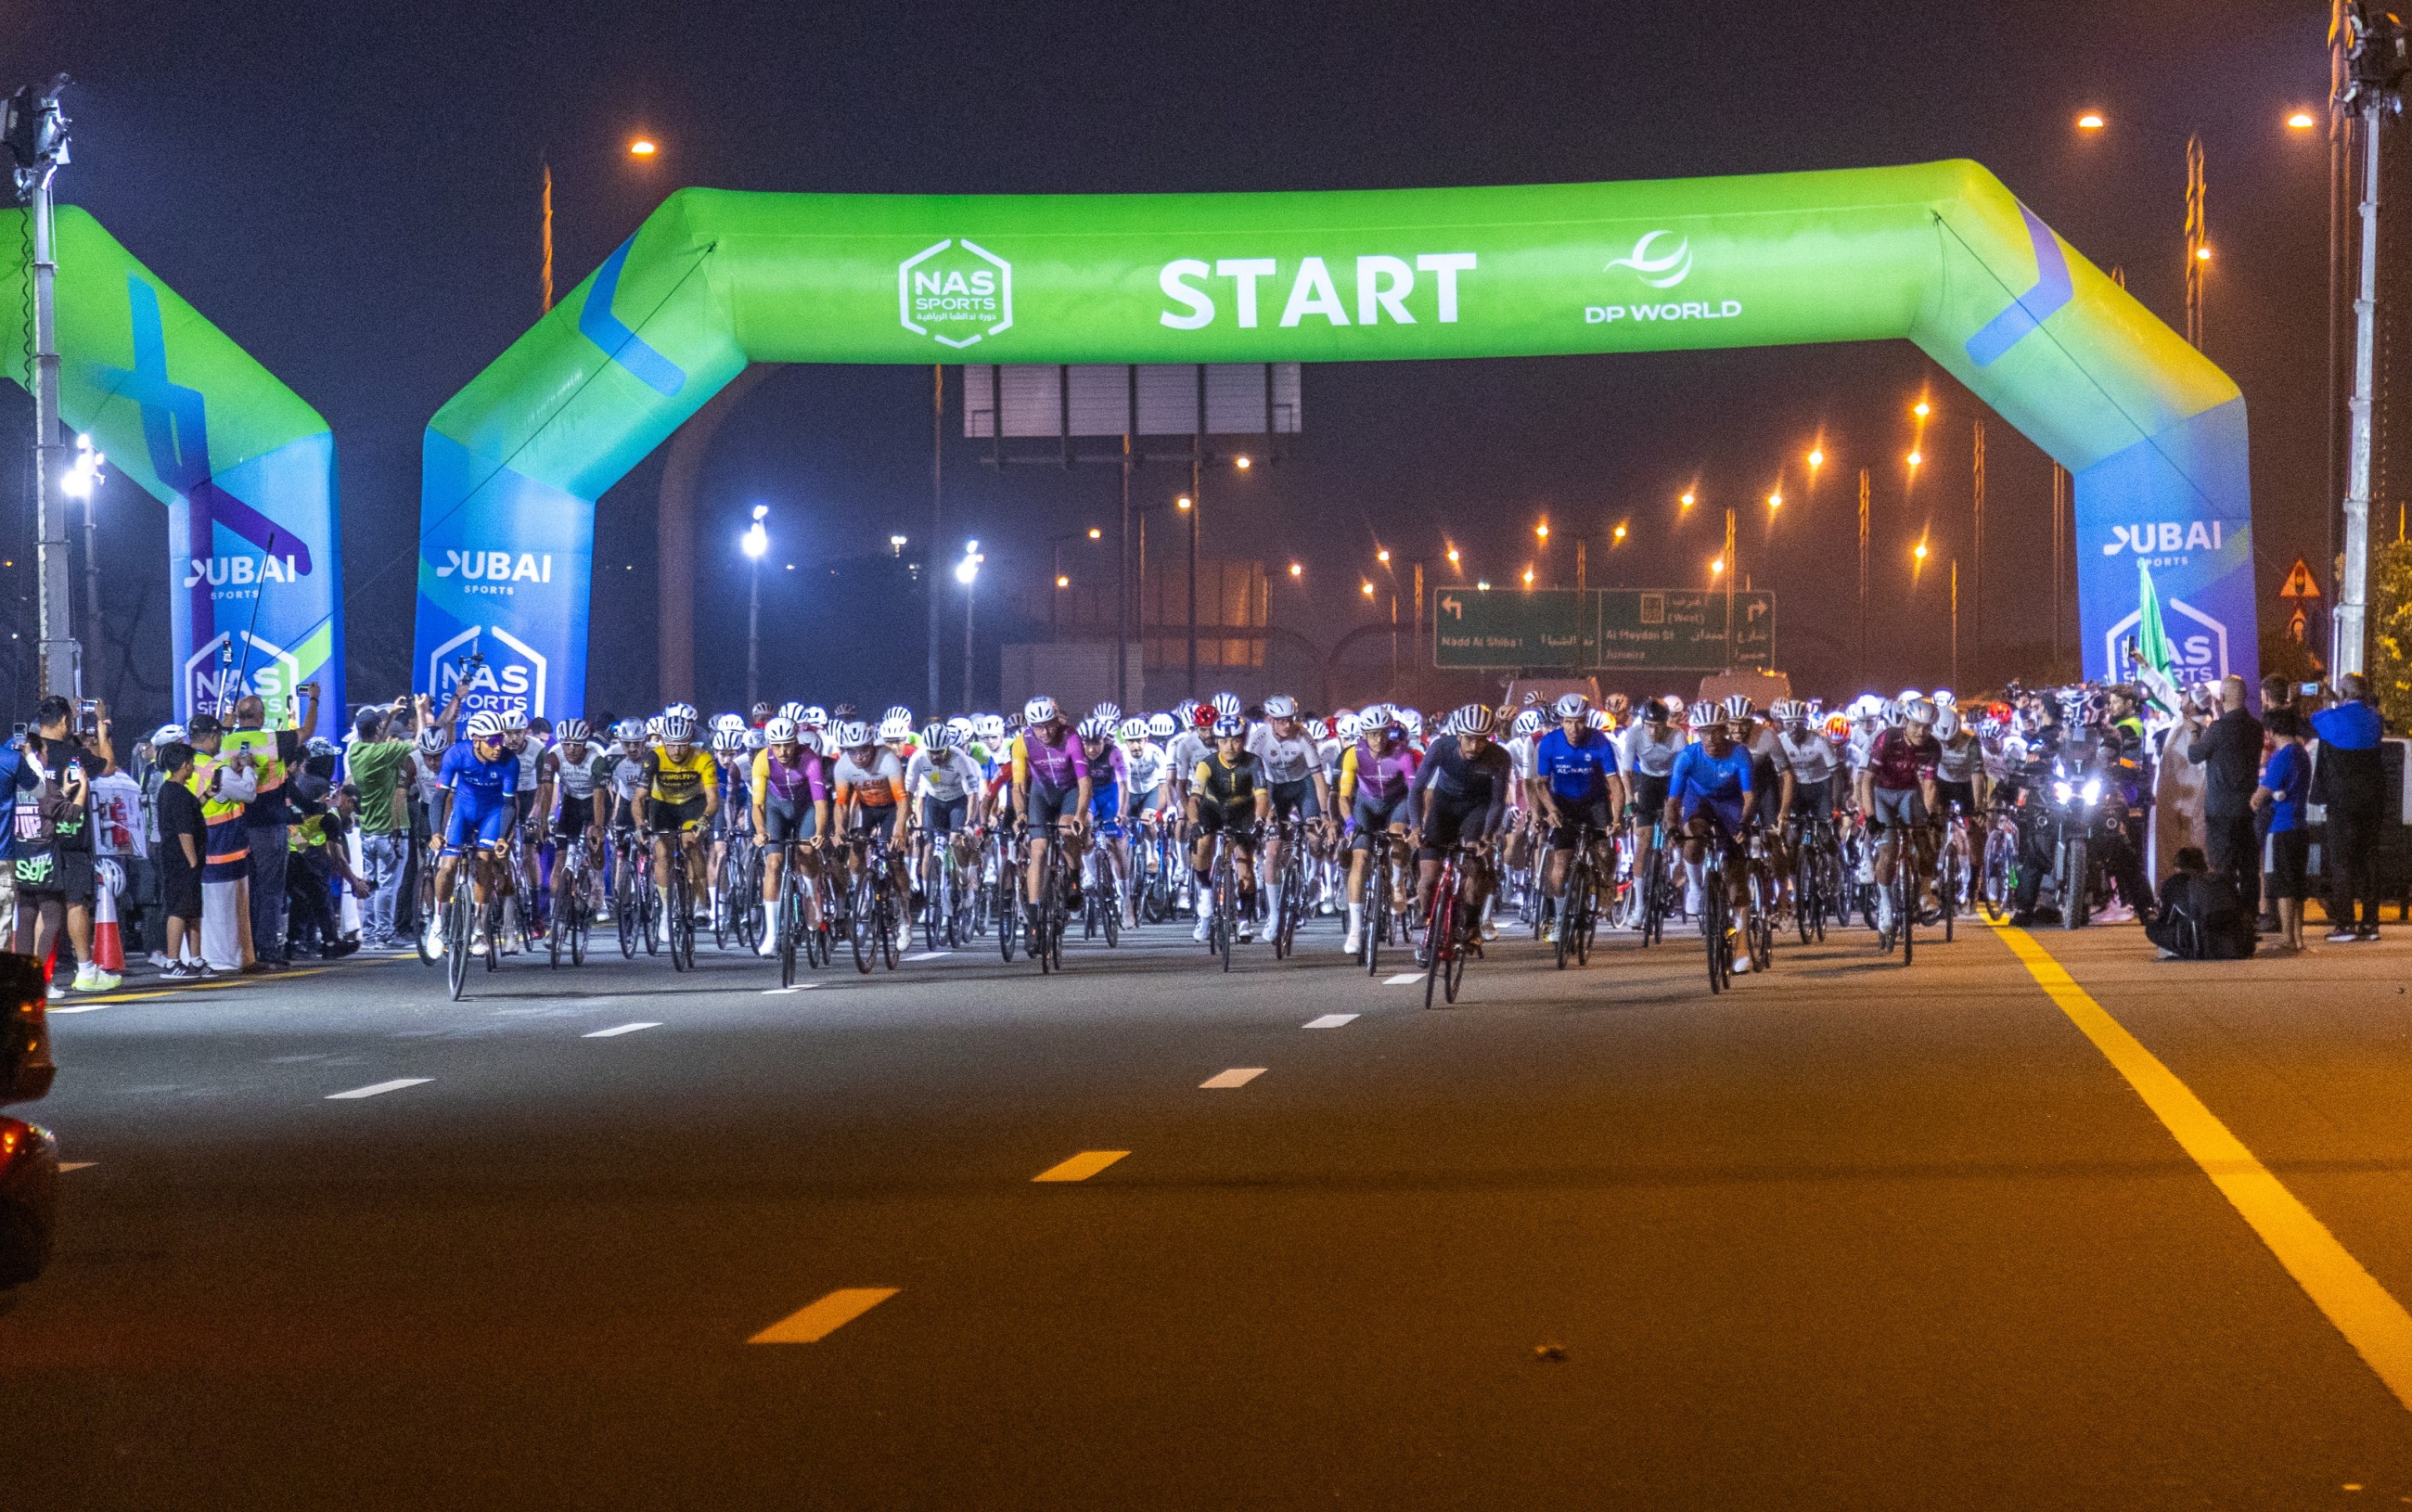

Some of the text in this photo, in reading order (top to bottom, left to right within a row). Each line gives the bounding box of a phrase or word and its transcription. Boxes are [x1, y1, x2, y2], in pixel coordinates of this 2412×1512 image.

[915, 270, 995, 296] NAS
[1159, 252, 1477, 330] START
[916, 297, 996, 311] SPORTS
[1584, 301, 1742, 324] DP WORLD
[211, 590, 260, 600] SPORTS
[464, 585, 515, 596] SPORTS
[196, 667, 282, 698] NAS
